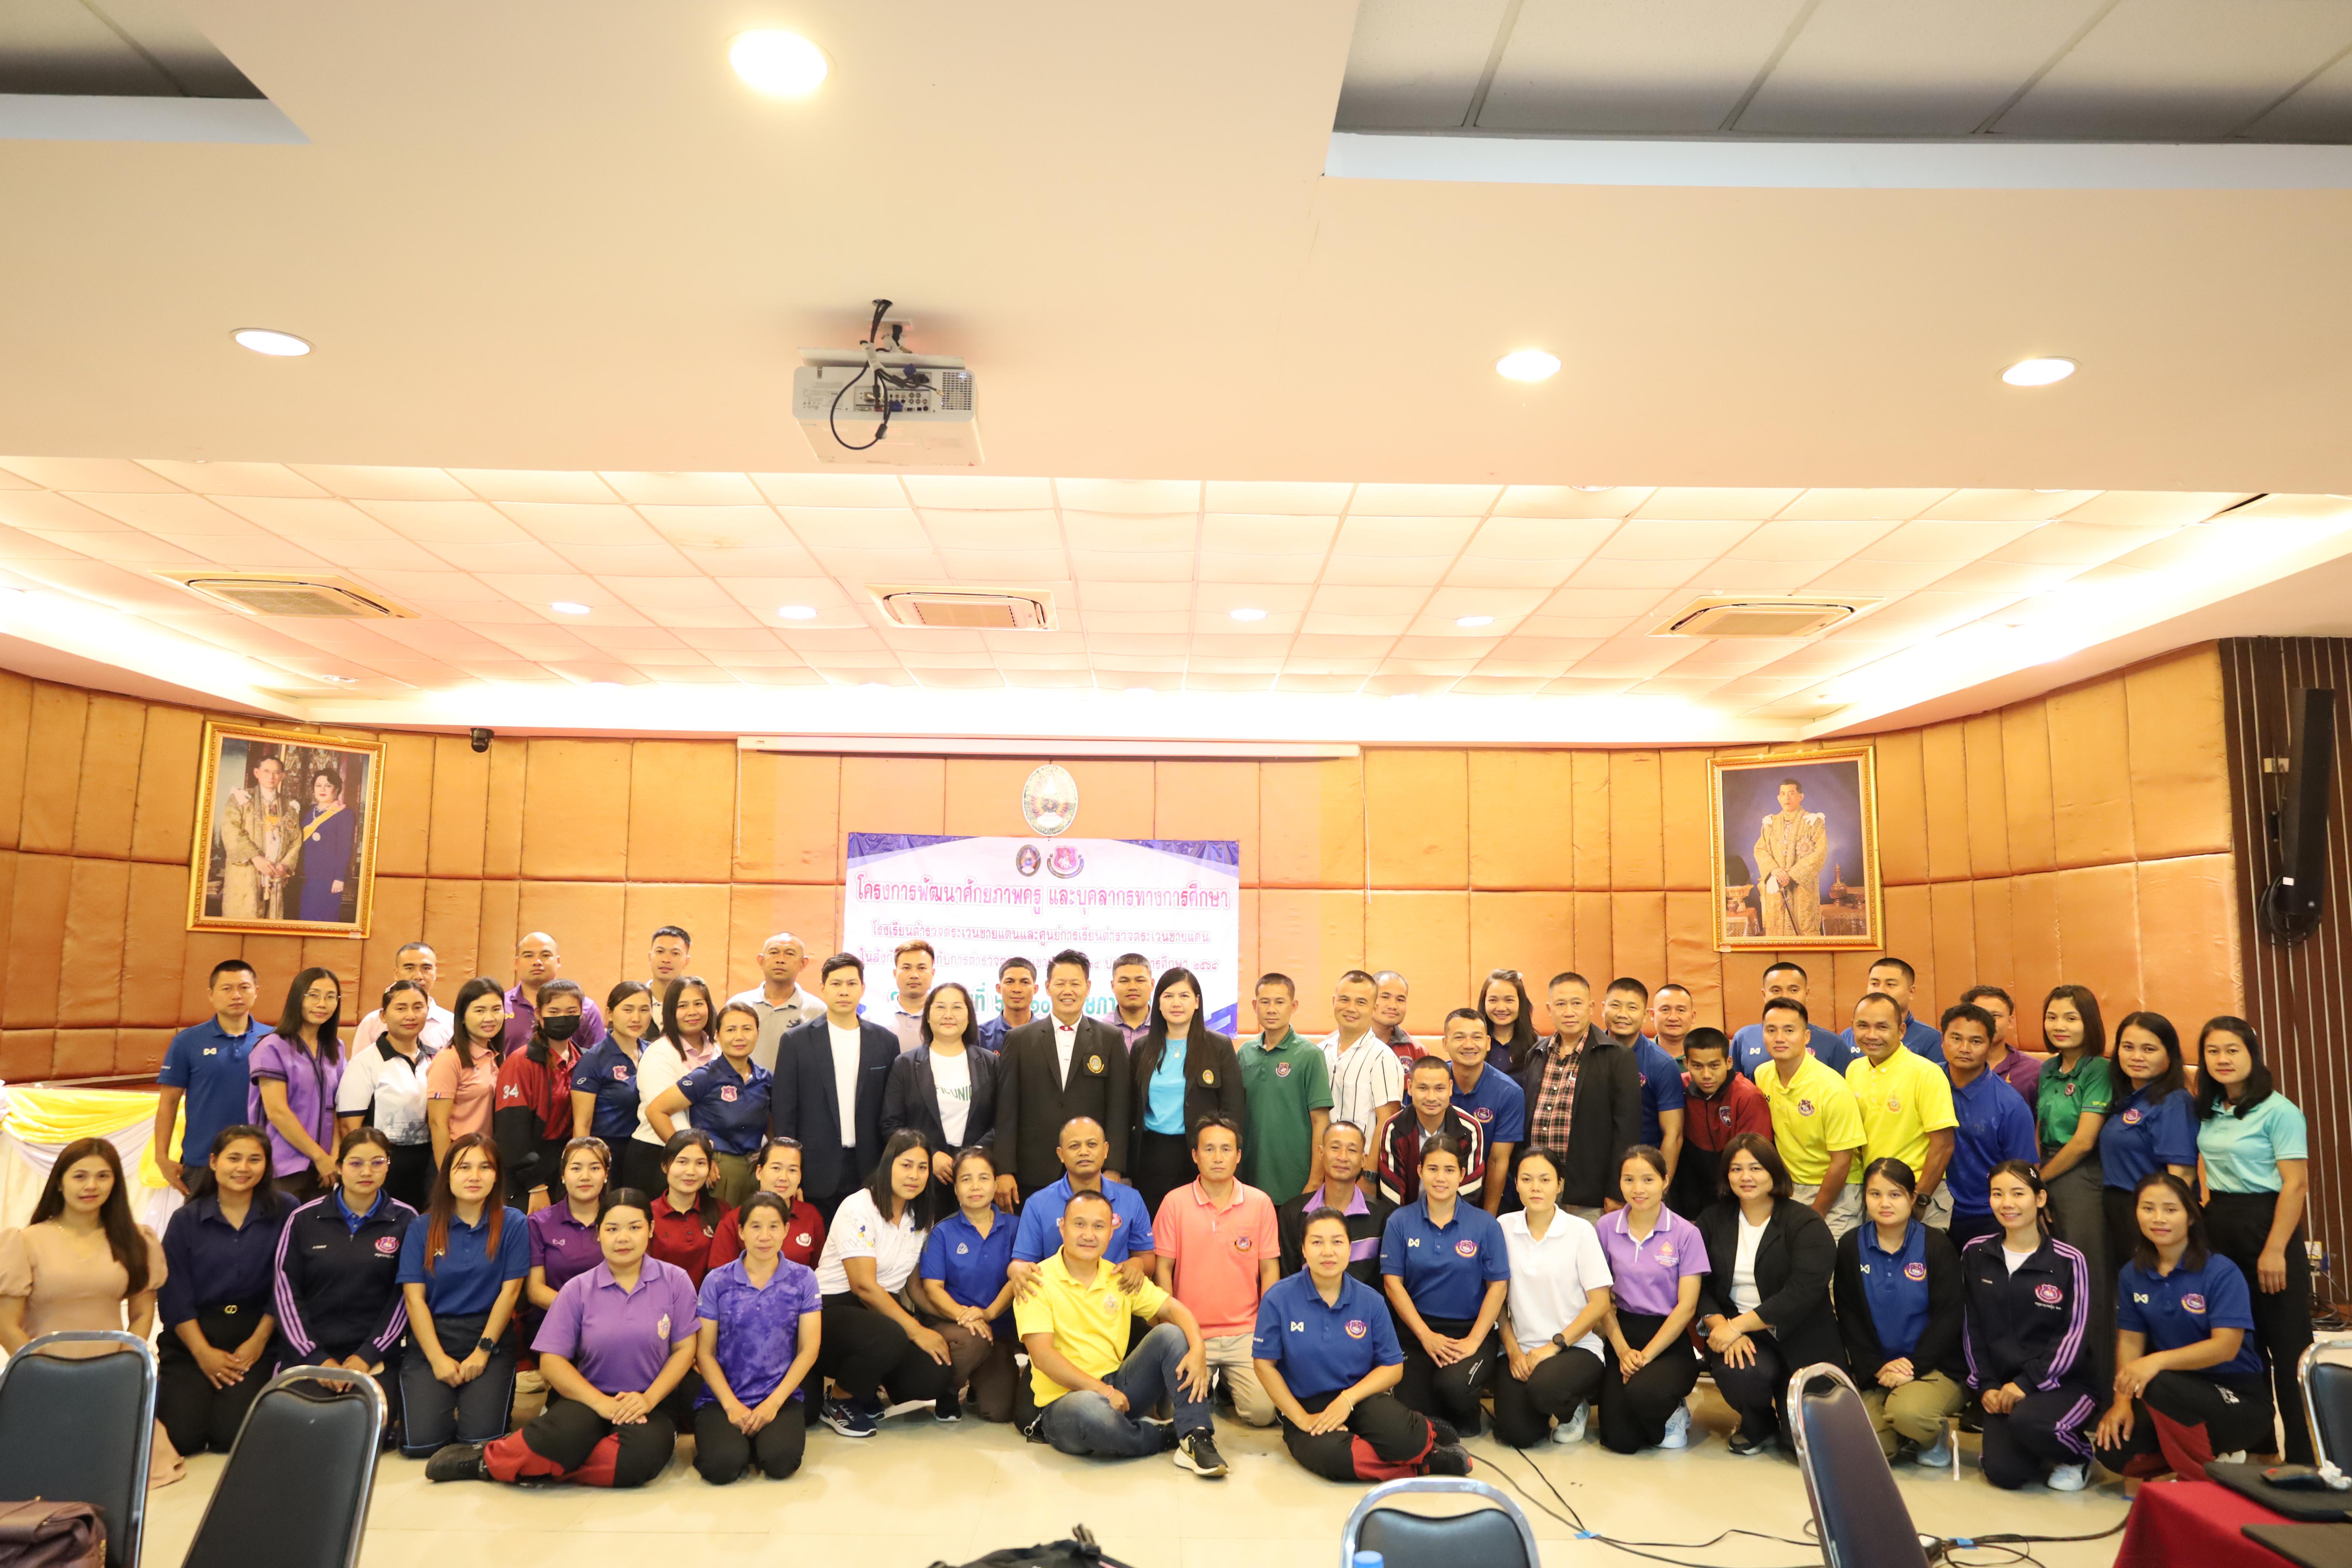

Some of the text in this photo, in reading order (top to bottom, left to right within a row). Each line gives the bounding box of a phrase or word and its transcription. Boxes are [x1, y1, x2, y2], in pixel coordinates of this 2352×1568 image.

[857, 874, 1228, 916] โครงการพัฒนาศักยภาพครู และบุคลากรทางการศึกษา
[1193, 960, 1218, 970] ๒๕๖๘
[503, 1083, 519, 1099] 34
